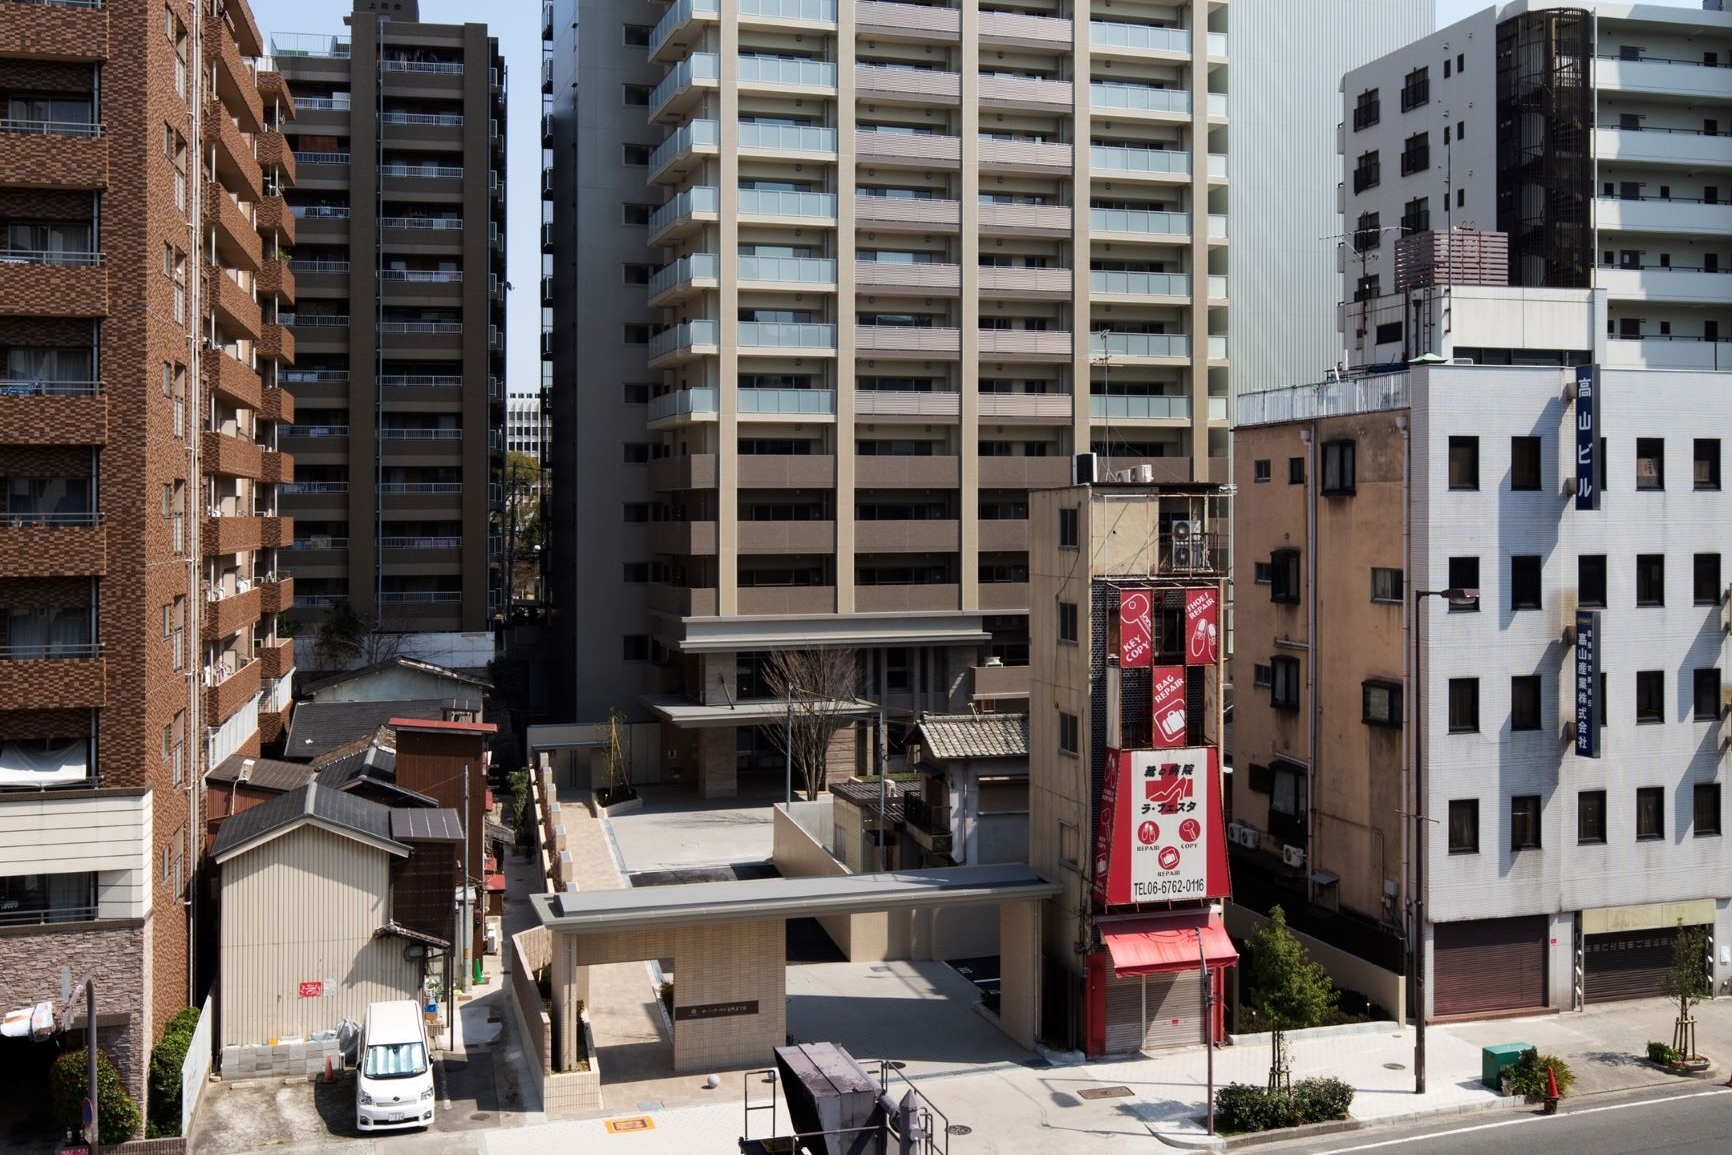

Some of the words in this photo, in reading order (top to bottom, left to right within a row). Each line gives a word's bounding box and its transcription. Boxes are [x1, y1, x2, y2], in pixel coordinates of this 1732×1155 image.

[1578, 377, 1593, 498] 高山ビル
[1187, 591, 1209, 613] SHOES
[1188, 597, 1215, 620] REPAIR
[1123, 634, 1141, 652] KEY
[1125, 641, 1150, 662] COPY
[1155, 678, 1184, 703] REPAIR
[1156, 674, 1175, 692] BAG
[1141, 801, 1197, 815] ラ・フェスタ
